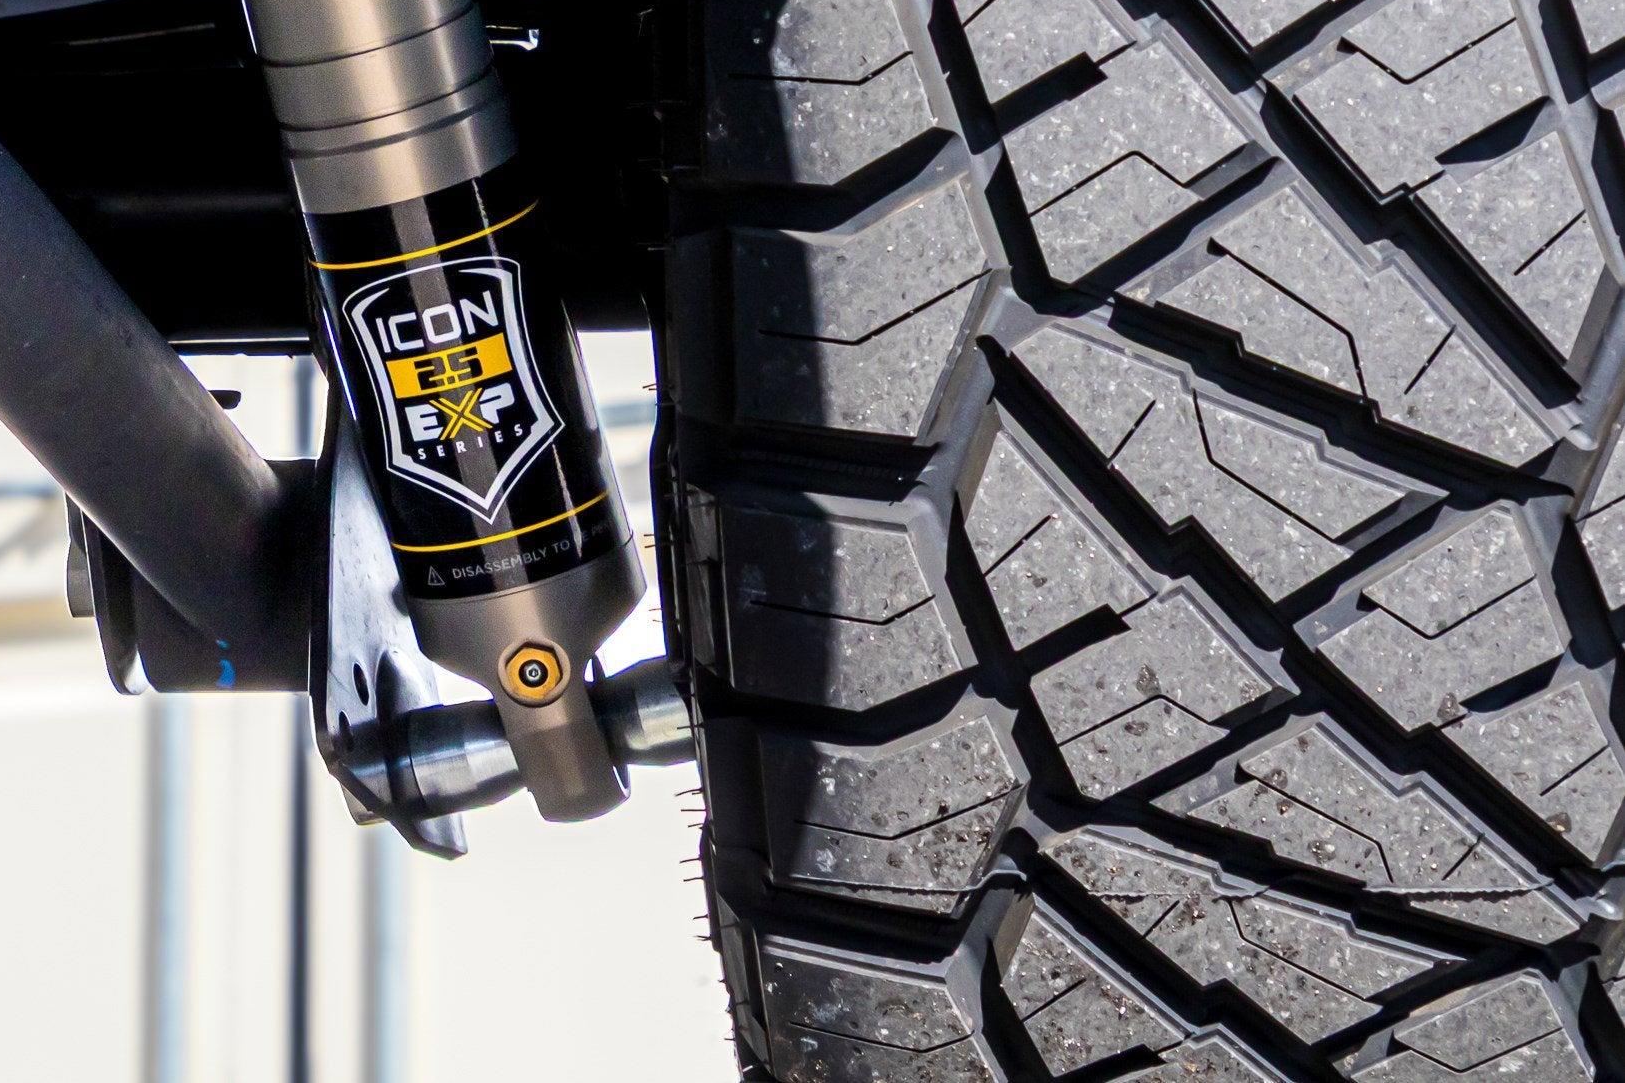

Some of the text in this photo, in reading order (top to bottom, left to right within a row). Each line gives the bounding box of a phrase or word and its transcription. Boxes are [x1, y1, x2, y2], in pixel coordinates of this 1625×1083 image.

[375, 290, 499, 353] ICON
[413, 346, 484, 391] 2.5
[404, 382, 515, 442] EXP
[418, 423, 524, 460] SERIES
[452, 546, 547, 579] DISASSEMBLY
[552, 539, 571, 554] TO
